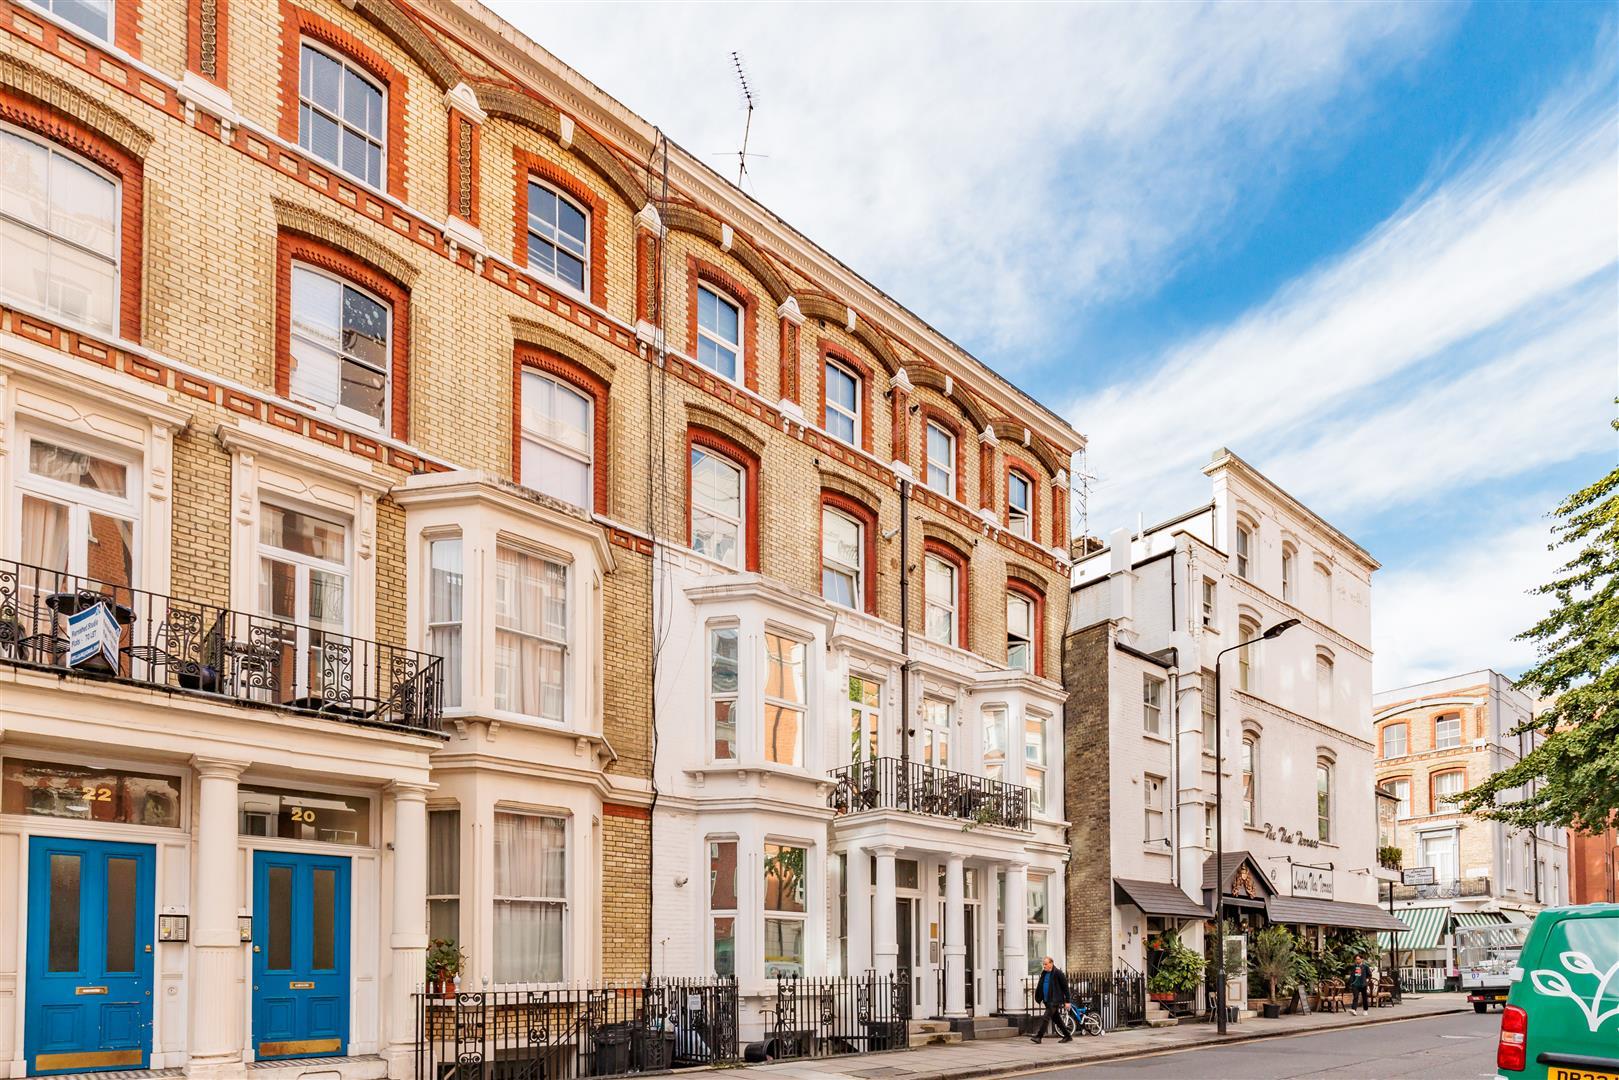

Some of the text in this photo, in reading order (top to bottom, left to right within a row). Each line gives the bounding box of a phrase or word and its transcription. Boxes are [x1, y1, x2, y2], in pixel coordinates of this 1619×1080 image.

[82, 786, 112, 802] 22
[291, 806, 316, 822] 20
[1263, 822, 1319, 849] The Thai Terrace
